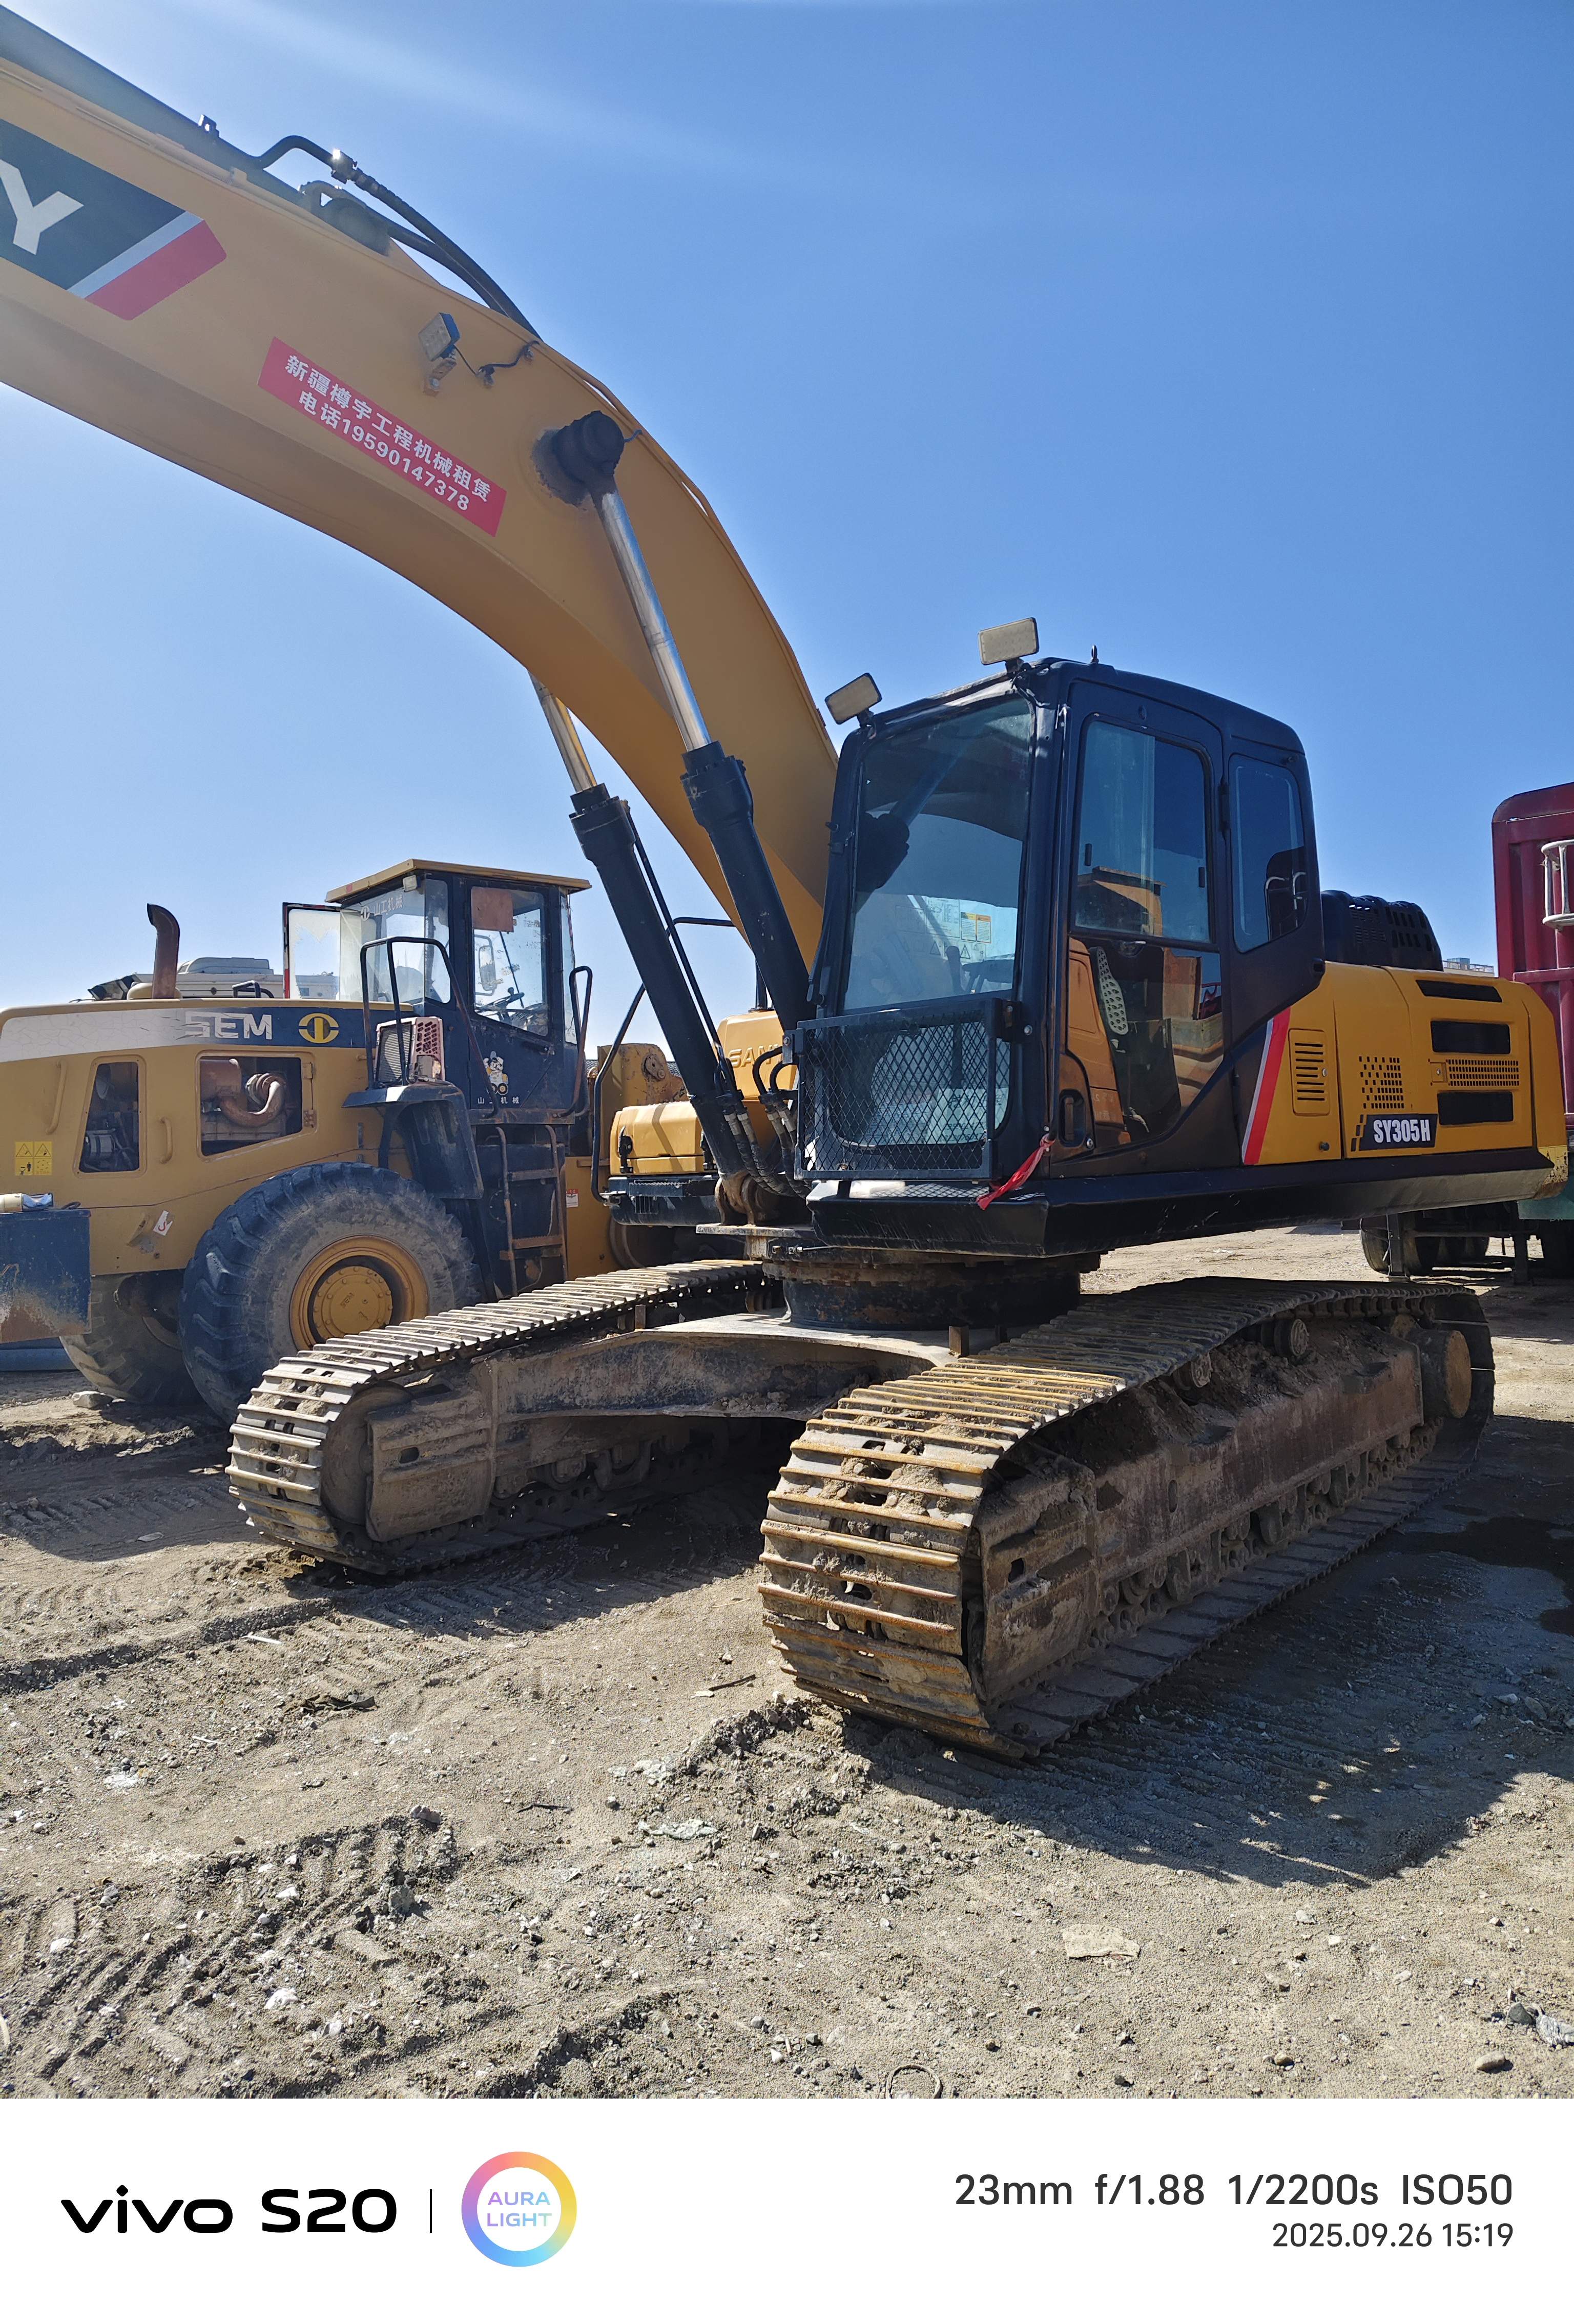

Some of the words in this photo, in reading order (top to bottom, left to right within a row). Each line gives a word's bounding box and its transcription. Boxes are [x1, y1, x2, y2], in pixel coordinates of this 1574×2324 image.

[0, 159, 84, 255] Y
[285, 355, 491, 502] 新疆樽宇工程机械租赁
[299, 391, 469, 510] 电话19590147378
[374, 895, 403, 916] 山工机械
[185, 1011, 272, 1040] SEM
[728, 1044, 783, 1068] SAN
[1373, 1119, 1431, 1143] SY305H
